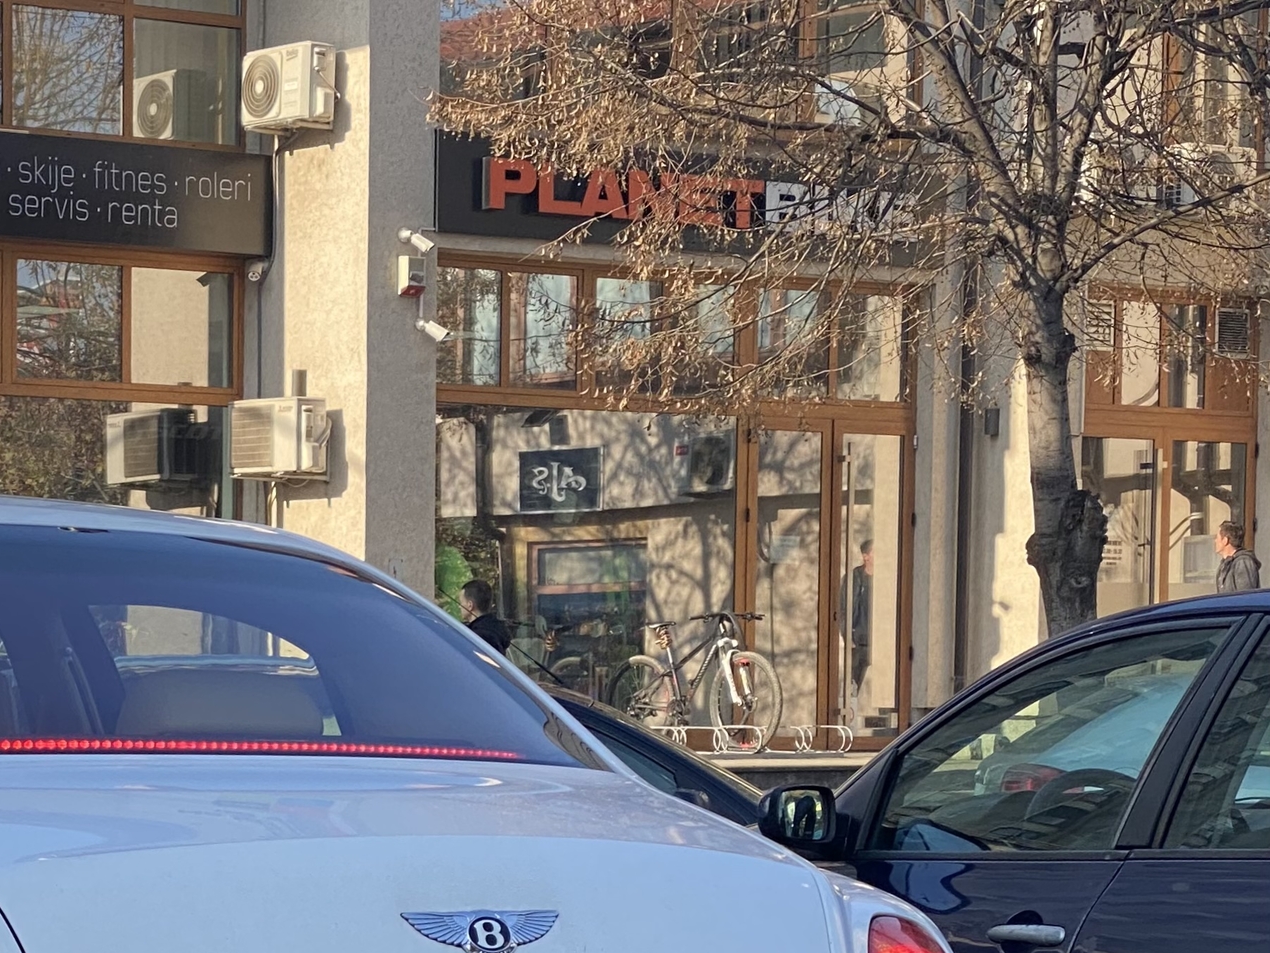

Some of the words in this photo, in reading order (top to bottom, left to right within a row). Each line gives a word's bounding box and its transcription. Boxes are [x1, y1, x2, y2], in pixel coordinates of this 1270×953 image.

[18, 156, 75, 193] skije
[93, 160, 167, 195] fitnes
[185, 172, 252, 201] roleri
[8, 191, 89, 221] servis
[107, 199, 179, 228] renta
[473, 918, 506, 950] B
